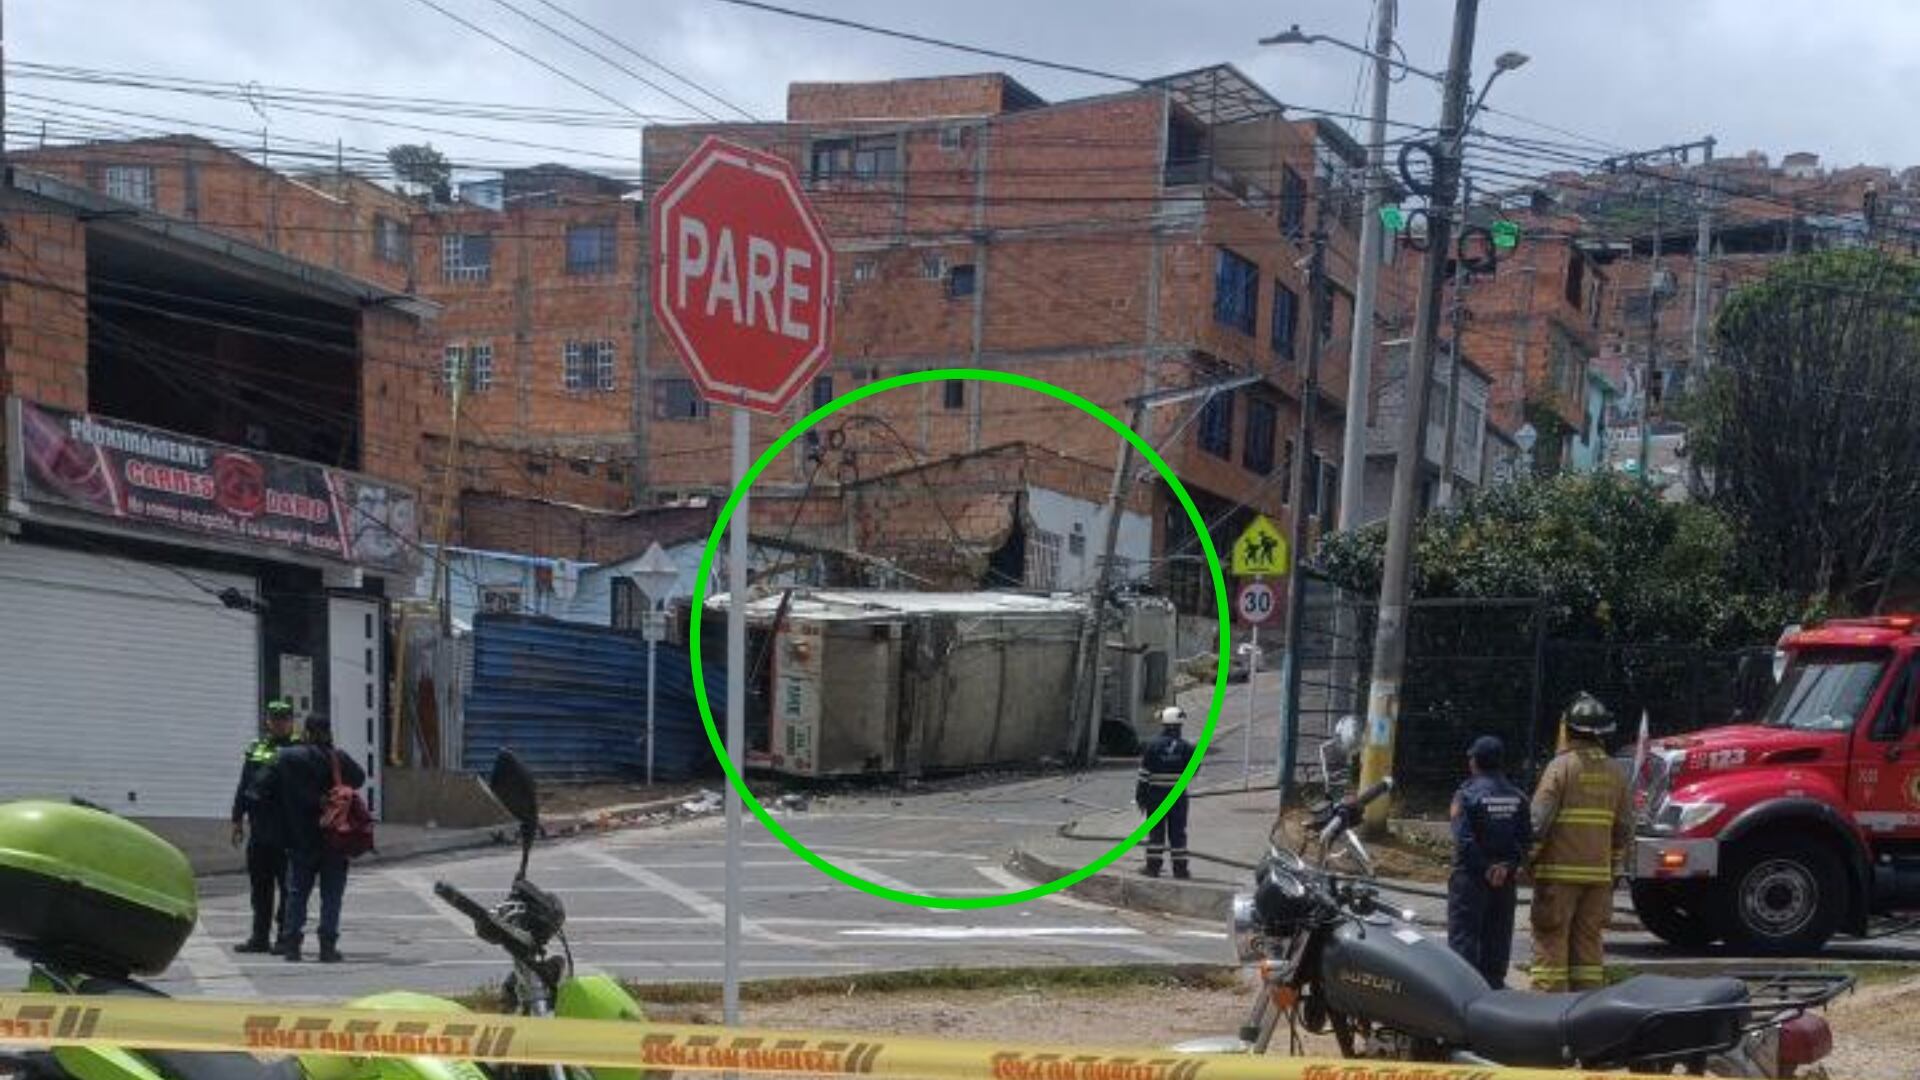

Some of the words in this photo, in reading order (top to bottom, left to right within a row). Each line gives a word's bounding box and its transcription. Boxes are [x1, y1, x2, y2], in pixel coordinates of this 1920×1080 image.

[679, 216, 811, 340] PARE
[126, 459, 215, 499] CARNES
[1245, 591, 1271, 612] 30
